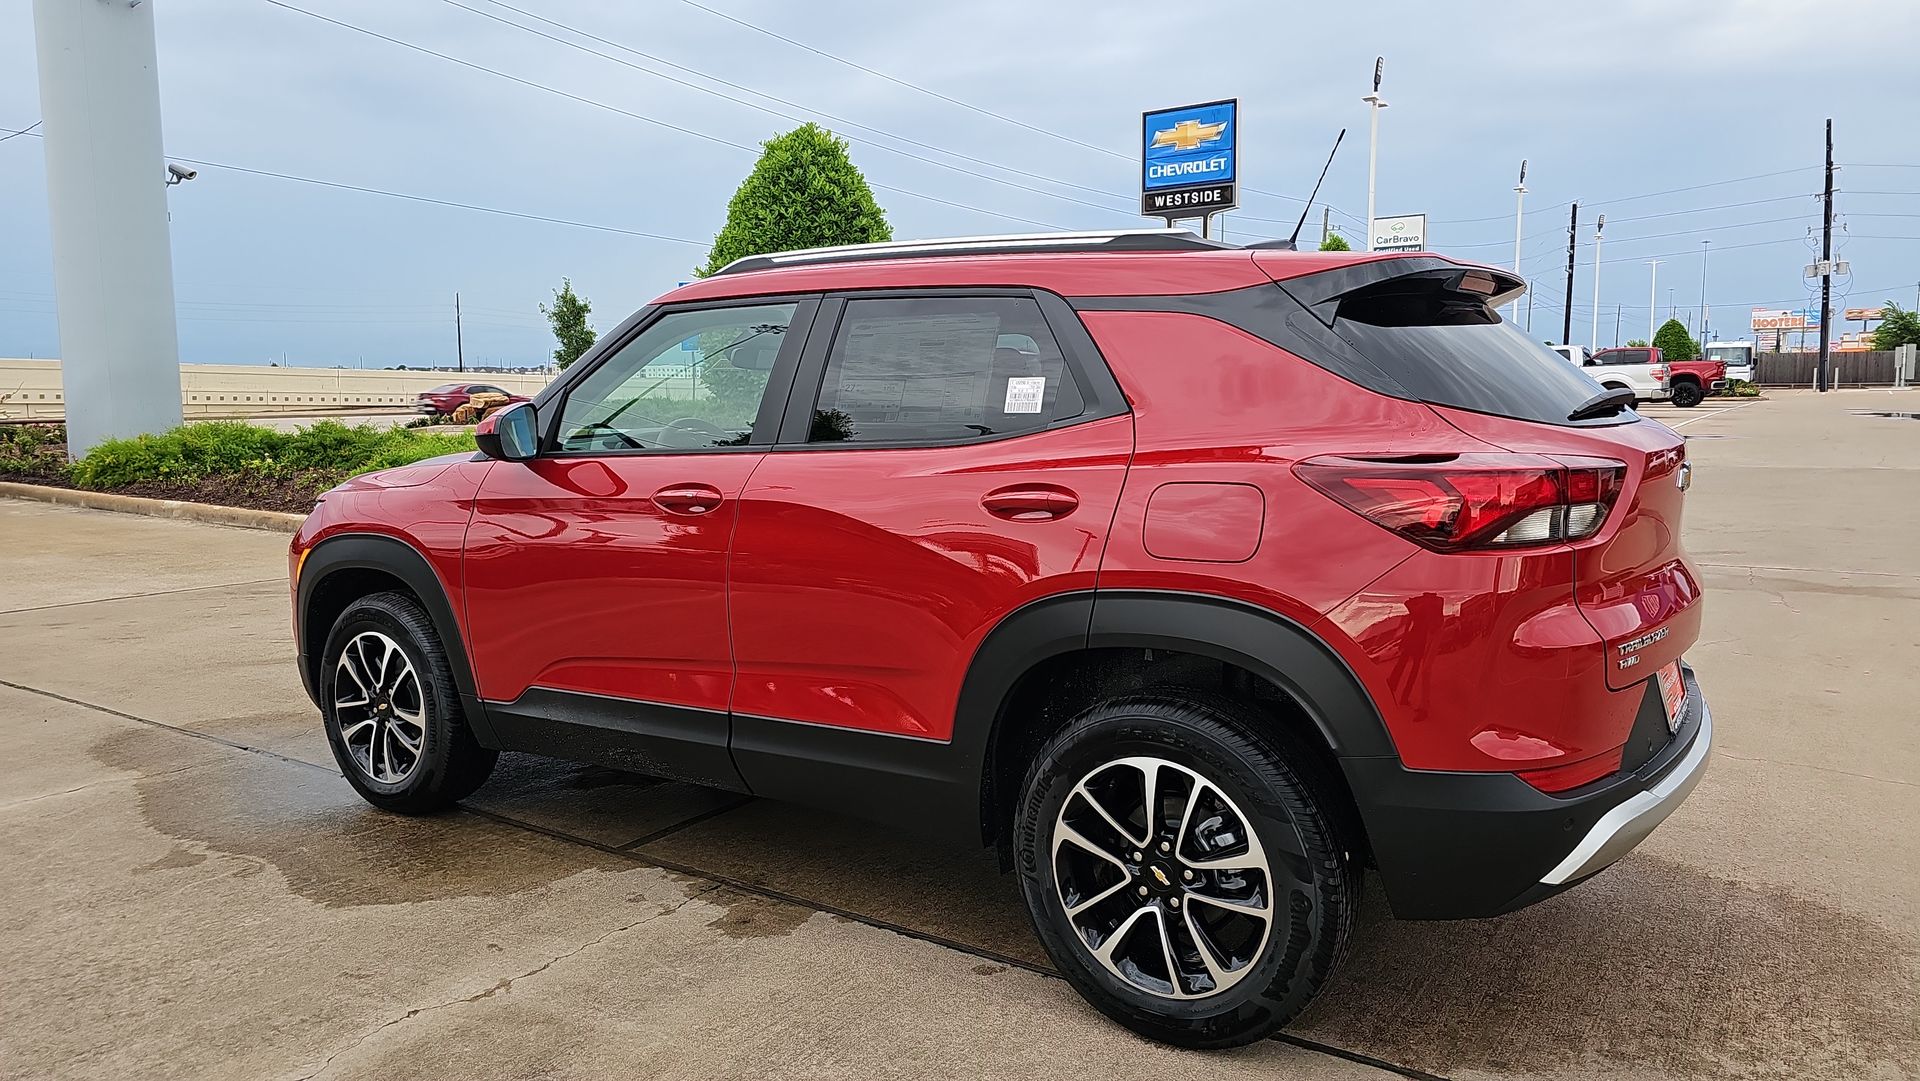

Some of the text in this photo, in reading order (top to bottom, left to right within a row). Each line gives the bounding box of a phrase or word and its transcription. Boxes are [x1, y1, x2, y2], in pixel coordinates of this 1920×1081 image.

[1149, 158, 1228, 178] CHEVROLET
[1155, 190, 1222, 207] WESTSIDE
[1376, 235, 1420, 245] CarBravo
[1752, 317, 1804, 328] HOOTERS
[1617, 655, 1640, 670] AWD
